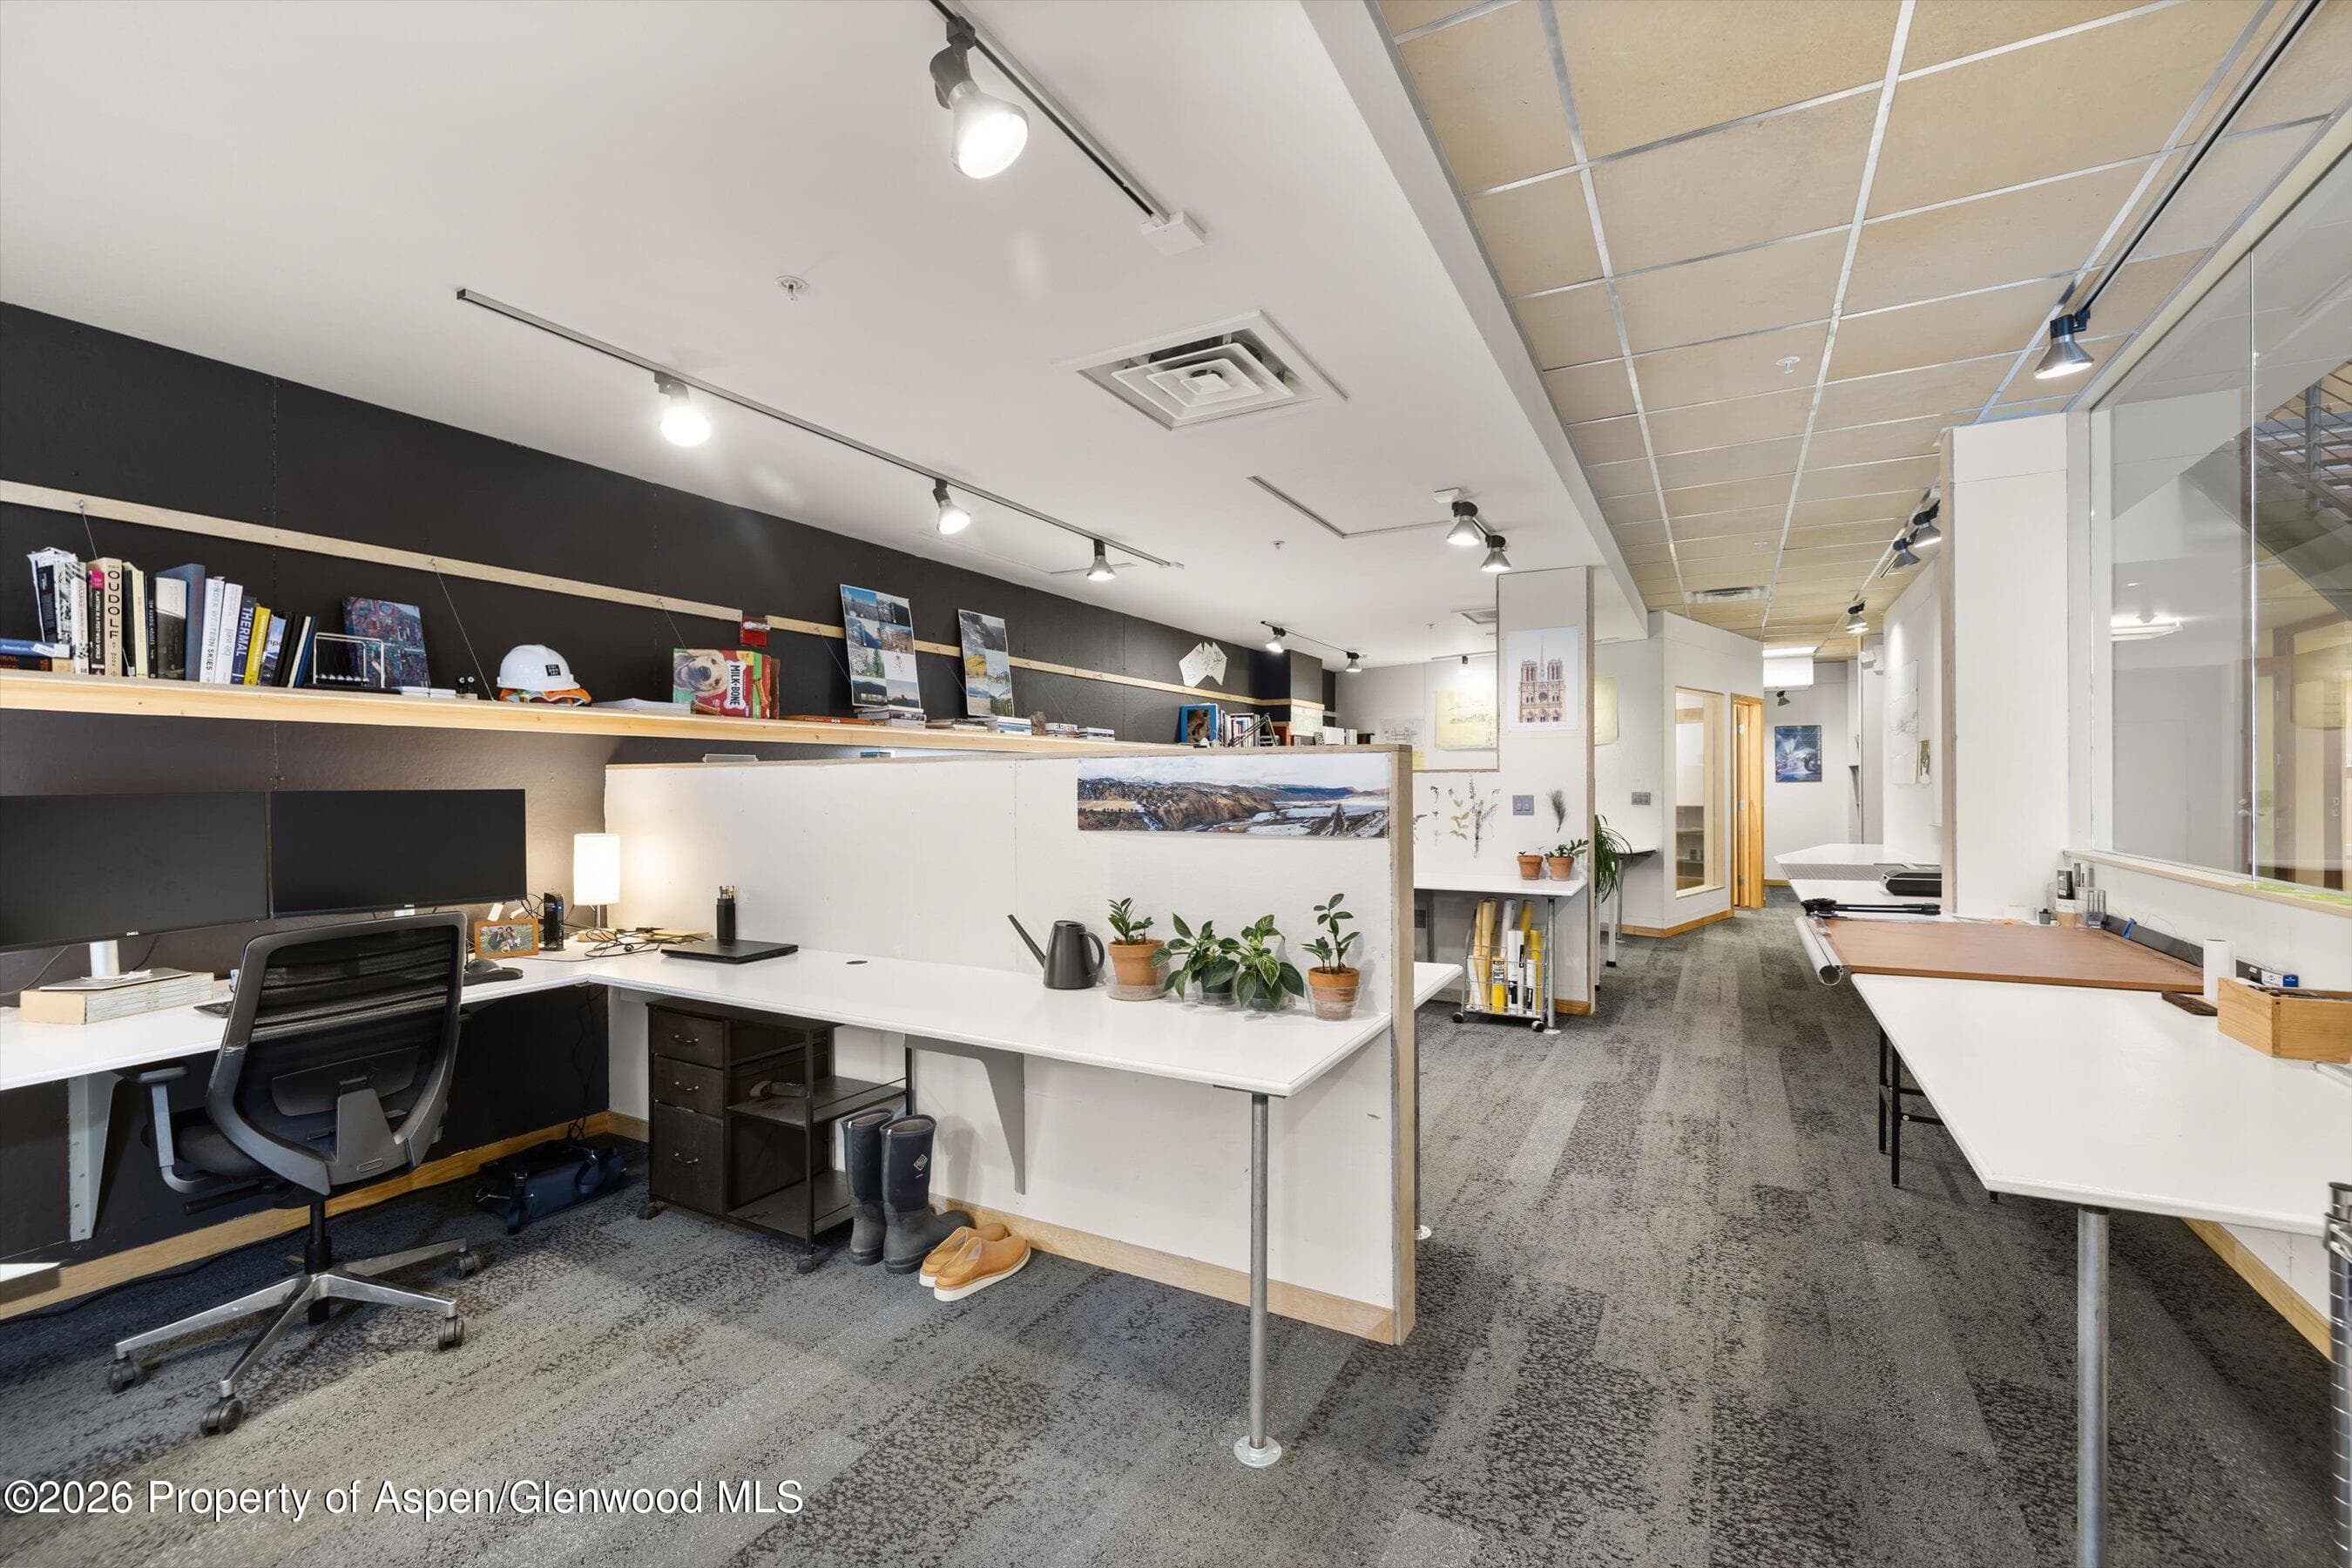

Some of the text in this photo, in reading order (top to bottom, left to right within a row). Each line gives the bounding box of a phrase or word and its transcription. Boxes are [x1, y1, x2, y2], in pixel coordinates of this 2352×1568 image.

[108, 571, 120, 639] OUDOLF
[212, 582, 220, 608] UNDER
[236, 607, 253, 656] THERMAL
